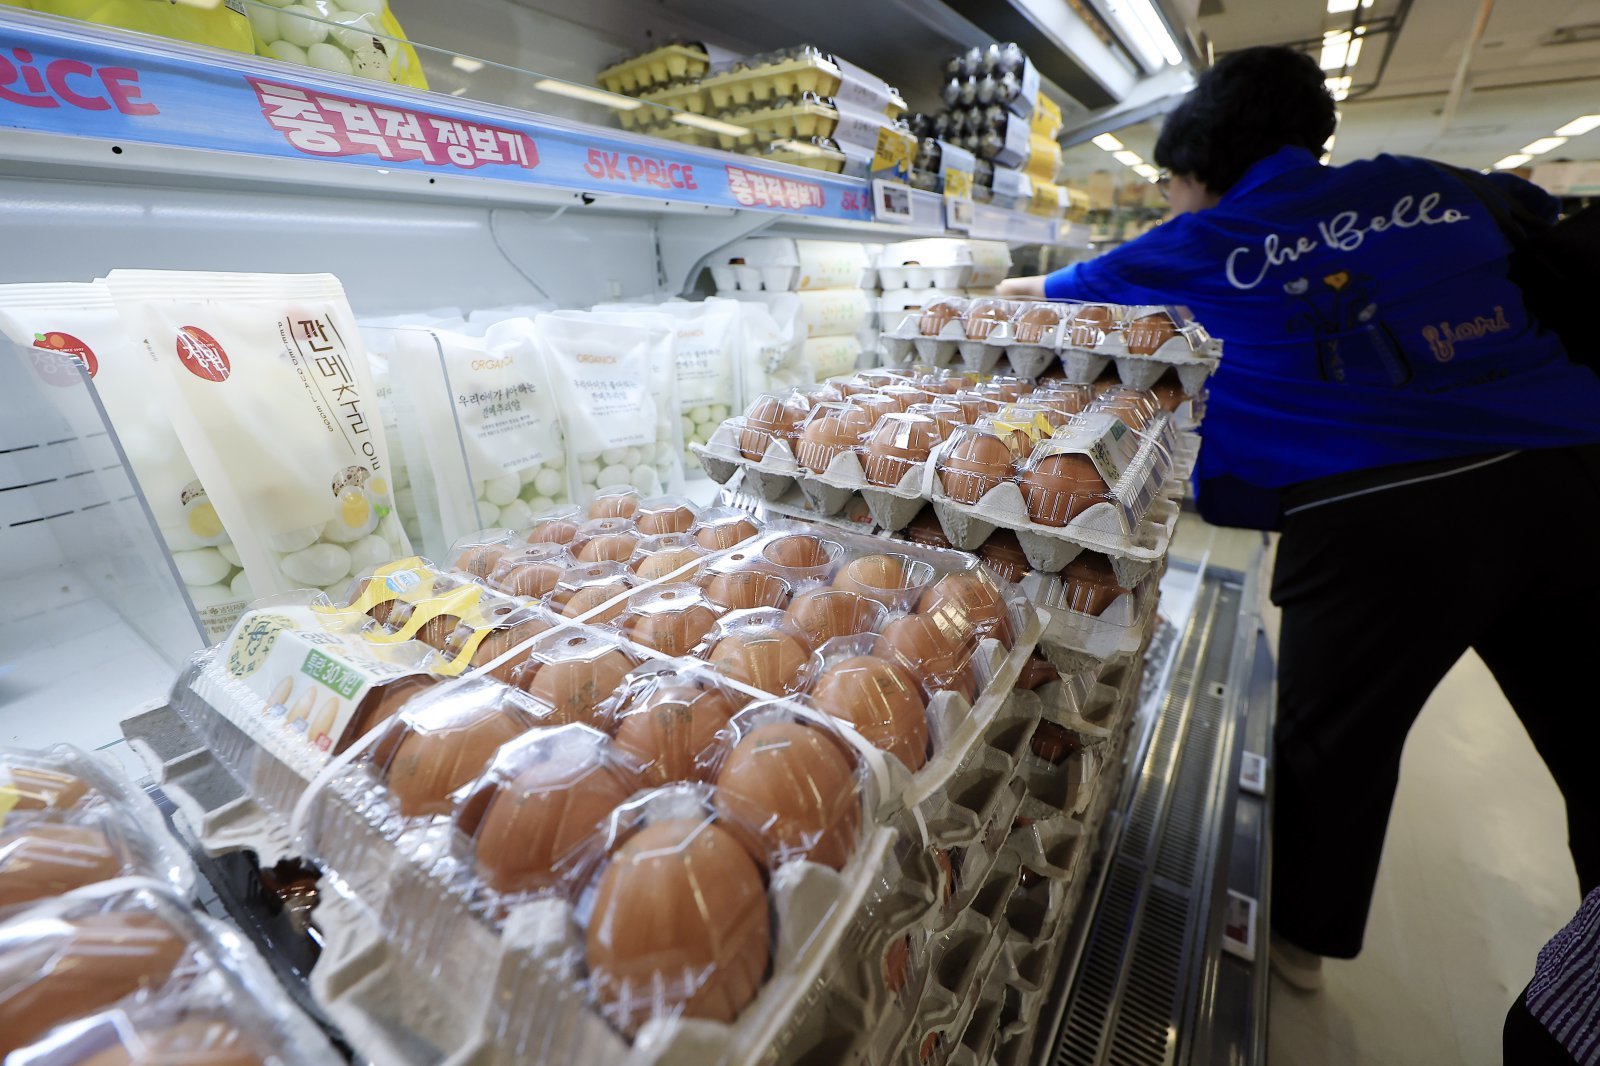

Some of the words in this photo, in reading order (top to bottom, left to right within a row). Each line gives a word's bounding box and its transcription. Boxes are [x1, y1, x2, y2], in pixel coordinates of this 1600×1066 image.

[256, 82, 435, 162] 충격적
[430, 118, 530, 166] 장보기
[584, 148, 625, 180] 5K
[728, 166, 786, 208] 충격적
[784, 181, 823, 209] 장보기
[1225, 233, 1318, 290] Che
[297, 319, 381, 471] 깐메추리알
[316, 405, 334, 432] EGGS
[306, 652, 328, 678] 특란
